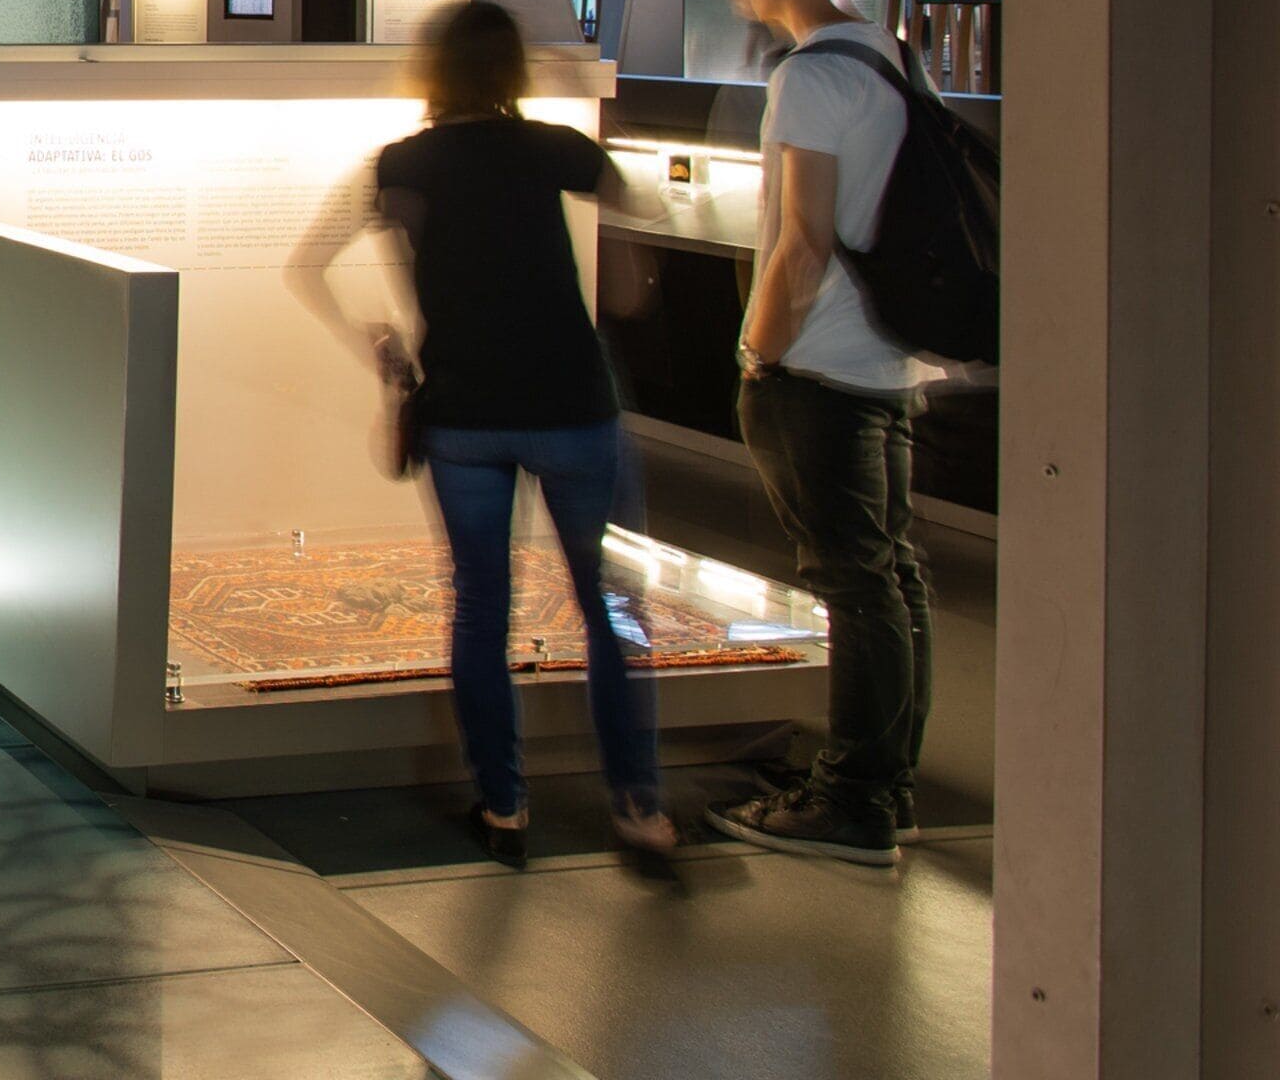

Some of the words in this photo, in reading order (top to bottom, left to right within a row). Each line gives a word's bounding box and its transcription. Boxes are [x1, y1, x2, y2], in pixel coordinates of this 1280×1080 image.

[28, 149, 106, 162] ADAPTATIVA:
[111, 149, 124, 162] EL
[128, 149, 153, 161] GOS
